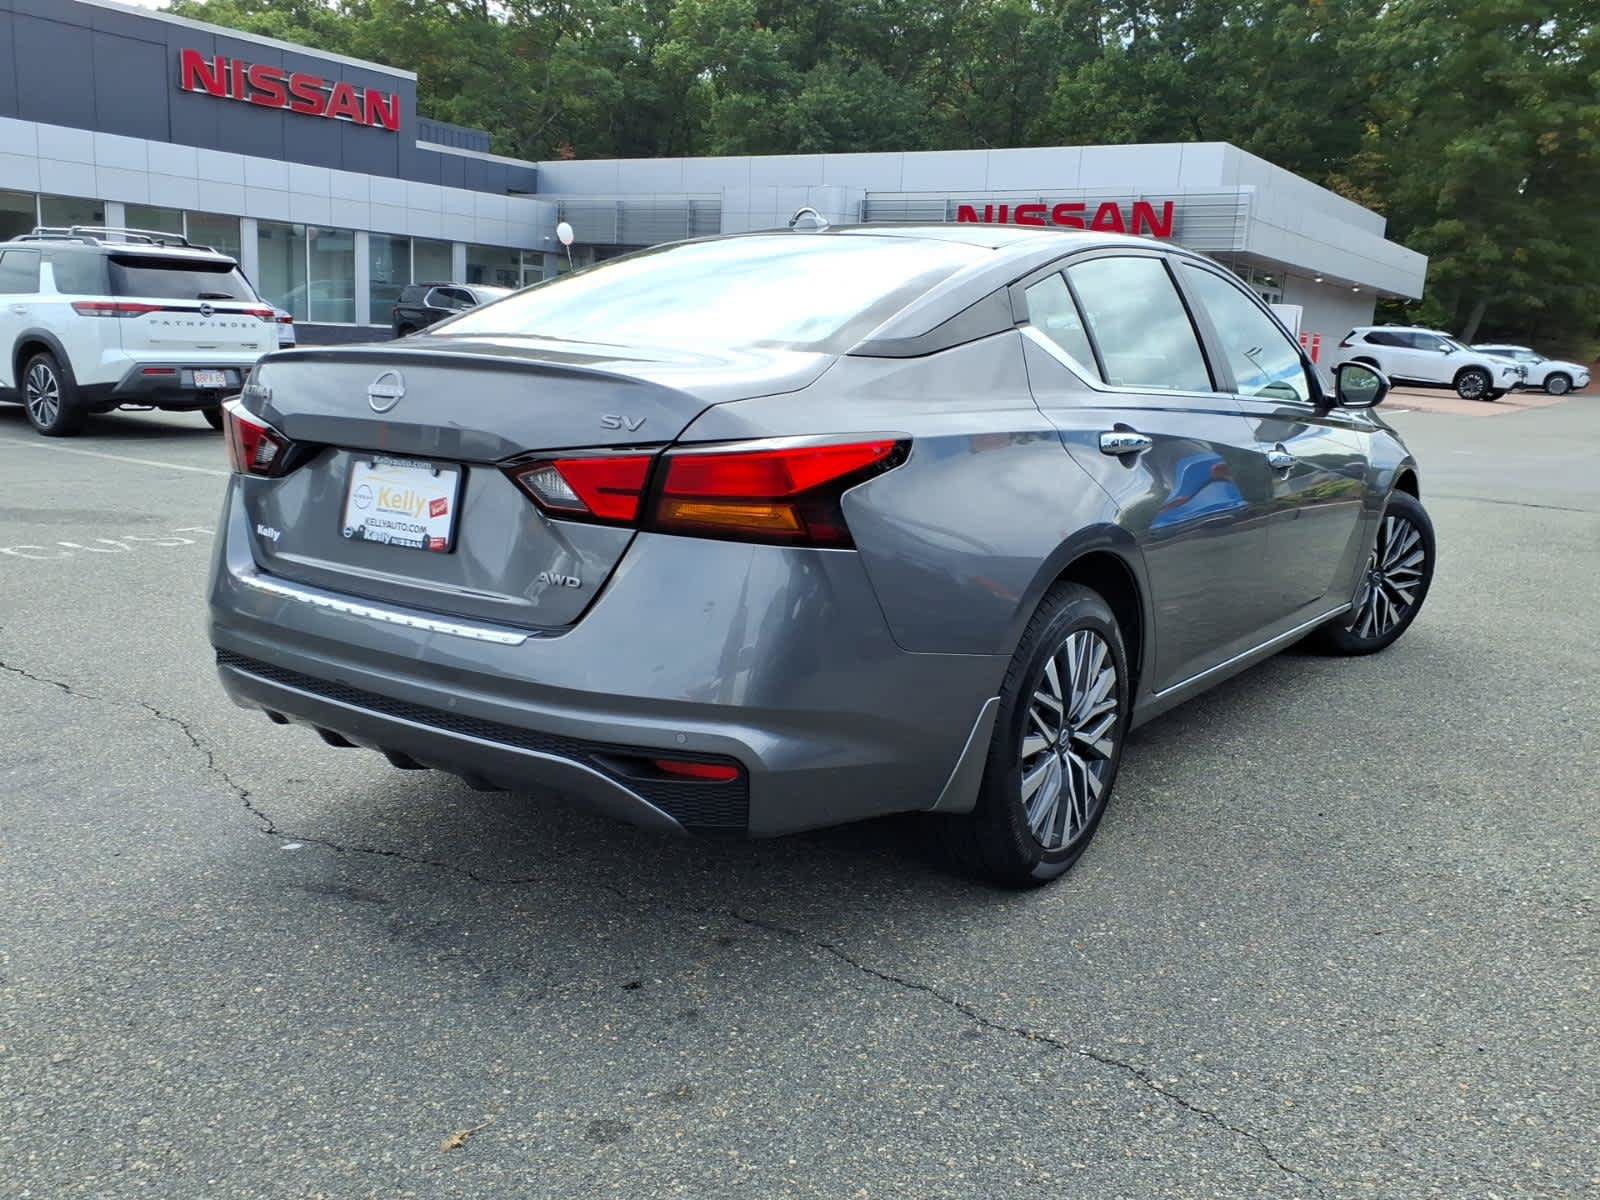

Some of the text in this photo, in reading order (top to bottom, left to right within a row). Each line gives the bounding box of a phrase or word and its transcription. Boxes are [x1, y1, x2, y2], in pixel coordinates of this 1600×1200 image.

[180, 48, 400, 132] NISSAN
[150, 319, 257, 328] PATHFINDER
[600, 414, 647, 432] SV
[378, 488, 426, 518] Kelly
[257, 524, 280, 541] Kelly
[365, 517, 427, 533] KELLYAUTO.COM
[539, 571, 582, 589] AWD
